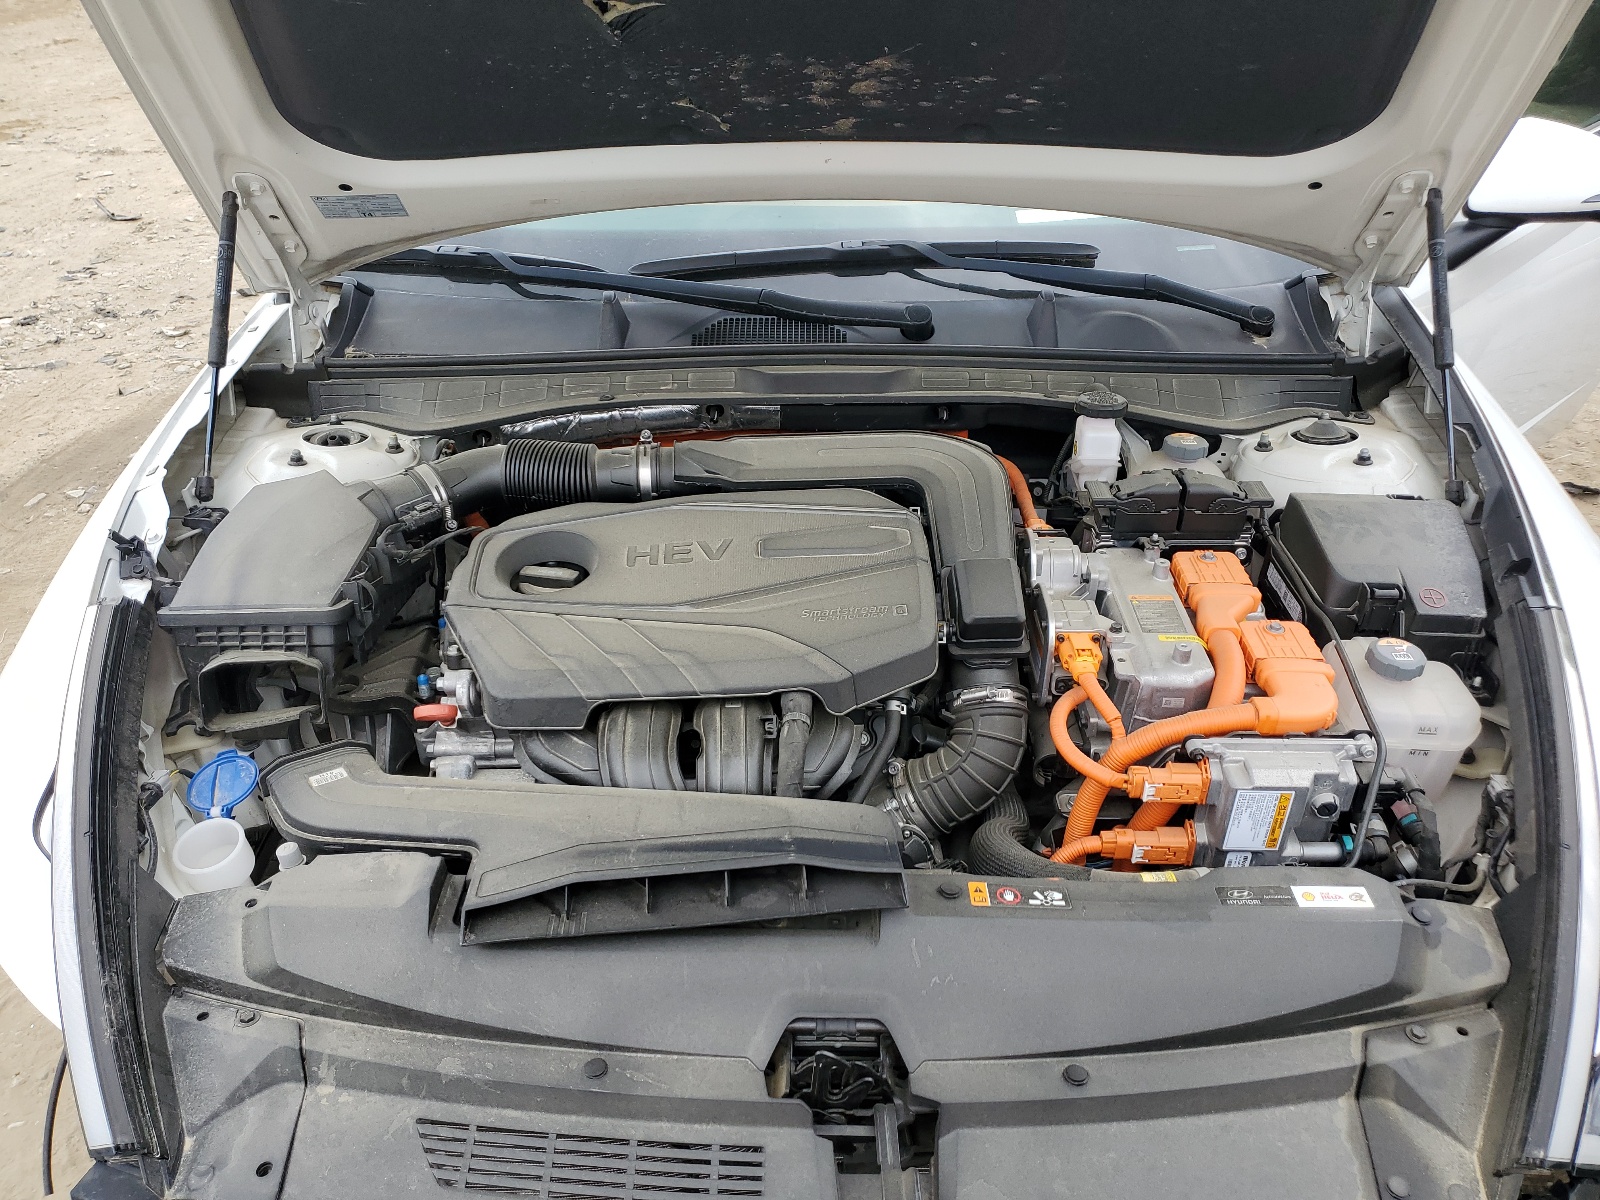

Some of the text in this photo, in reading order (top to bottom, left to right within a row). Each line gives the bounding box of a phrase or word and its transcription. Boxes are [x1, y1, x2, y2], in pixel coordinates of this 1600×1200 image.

[626, 538, 734, 568] HEV
[801, 605, 889, 618] Smartstream
[812, 612, 887, 622] TECHNOLOGY
